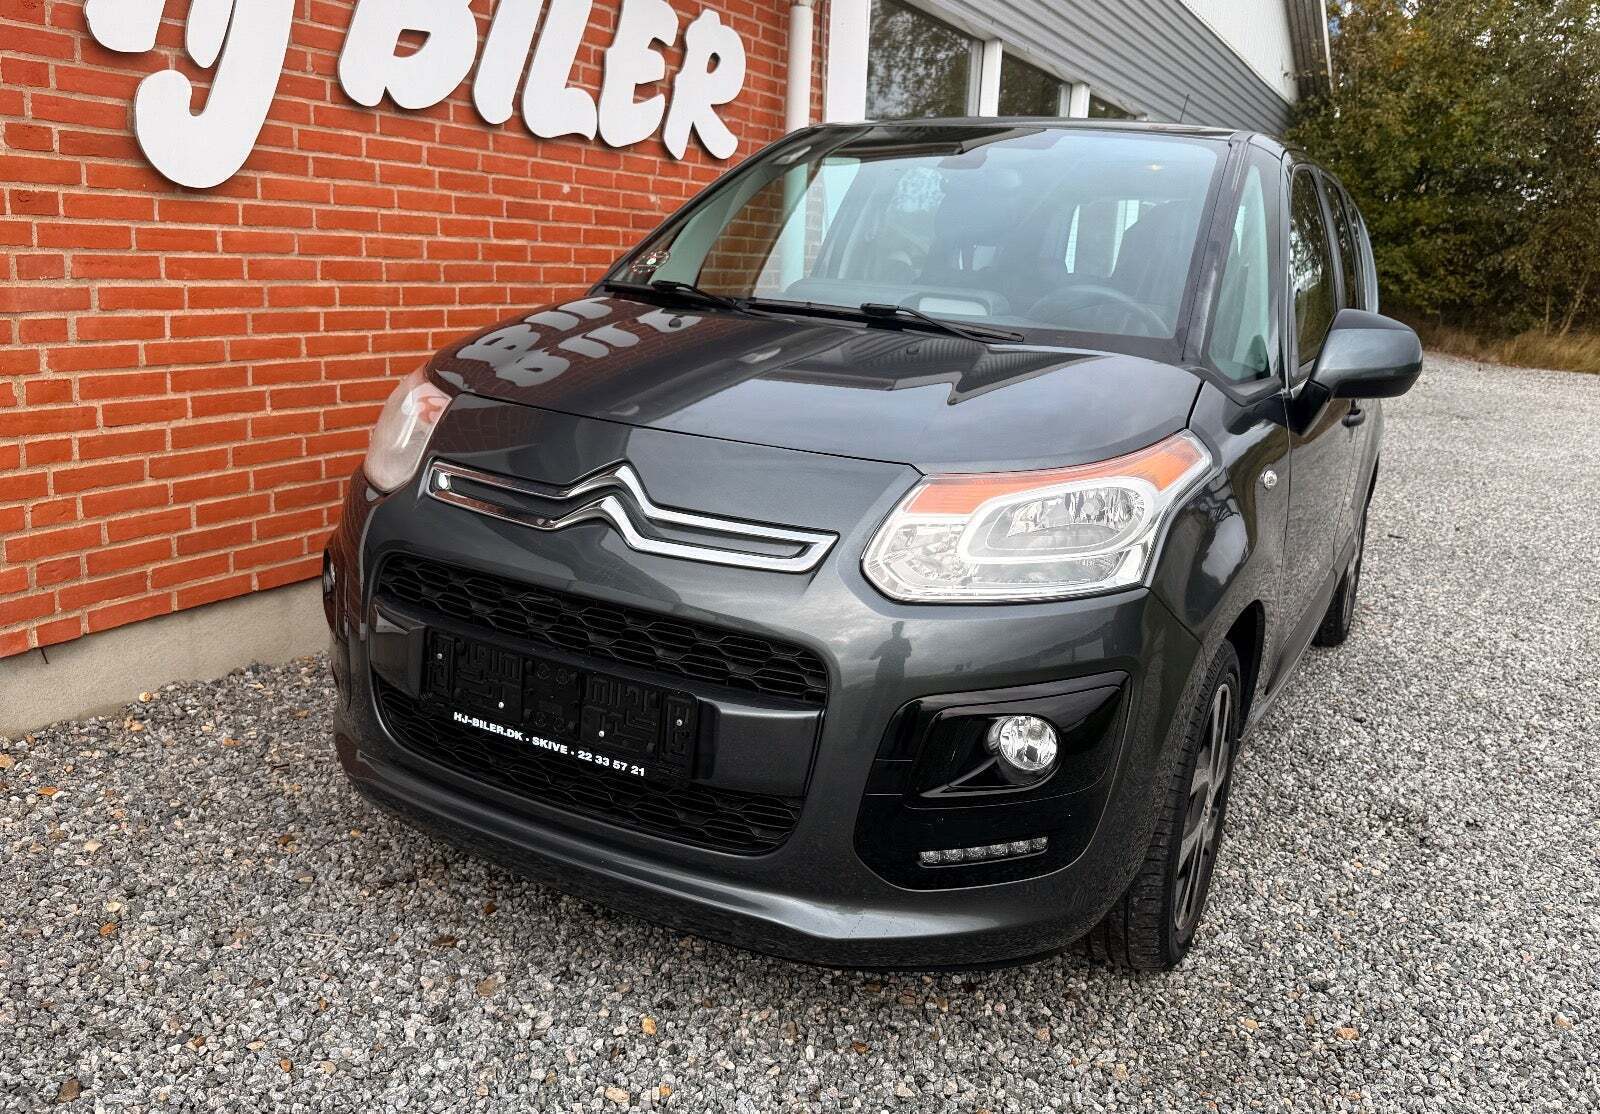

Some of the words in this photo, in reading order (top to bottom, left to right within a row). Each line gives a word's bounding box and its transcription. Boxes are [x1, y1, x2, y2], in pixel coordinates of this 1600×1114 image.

[338, 0, 747, 160] BILER
[453, 711, 524, 742] HJ-BILER.DK
[531, 736, 568, 755] SKIVE
[577, 750, 593, 762] 22
[594, 755, 610, 767] 33
[612, 759, 628, 772] 57
[630, 765, 645, 777] 21
